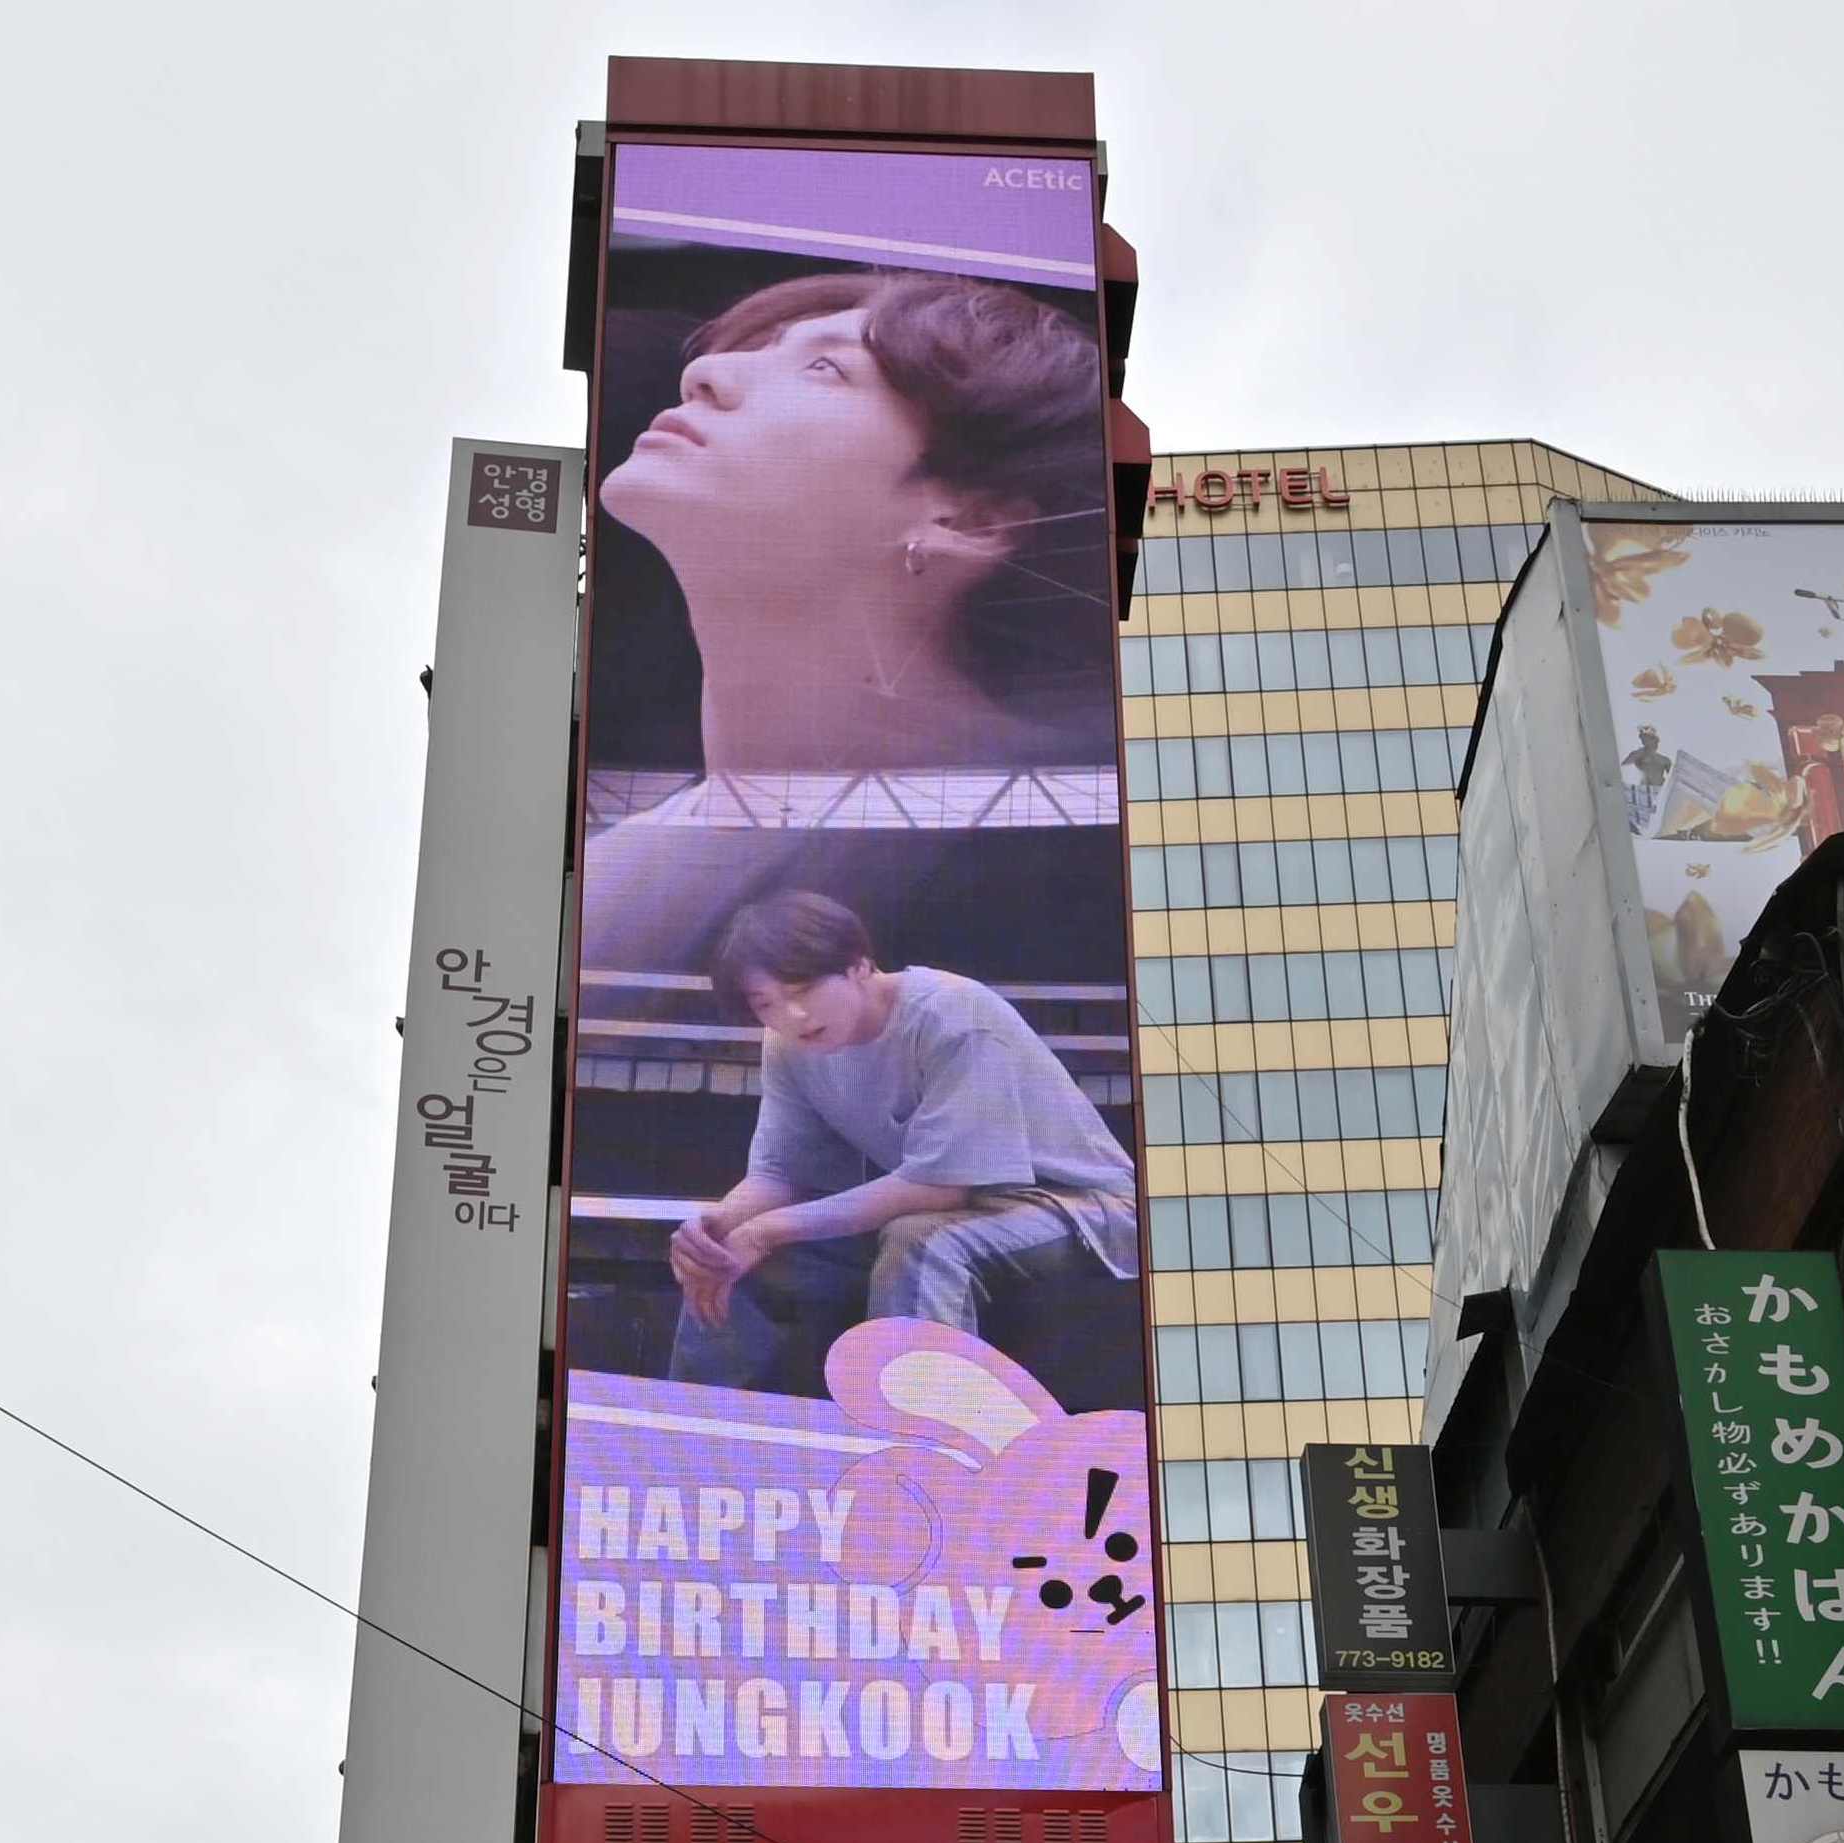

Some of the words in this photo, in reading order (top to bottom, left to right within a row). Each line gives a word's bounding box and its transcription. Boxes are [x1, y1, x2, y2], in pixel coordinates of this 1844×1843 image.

[983, 167, 1084, 193] ACEtic
[483, 463, 549, 495] 안경
[1147, 465, 1352, 510] HOTEL
[577, 1485, 856, 1563] HAPPY
[574, 1580, 1015, 1662] BIRTHDAY
[1334, 1648, 1446, 1671] 773-9182
[566, 1677, 1041, 1762] JUNGKOOK
[1343, 1702, 1406, 1725] 옷수선
